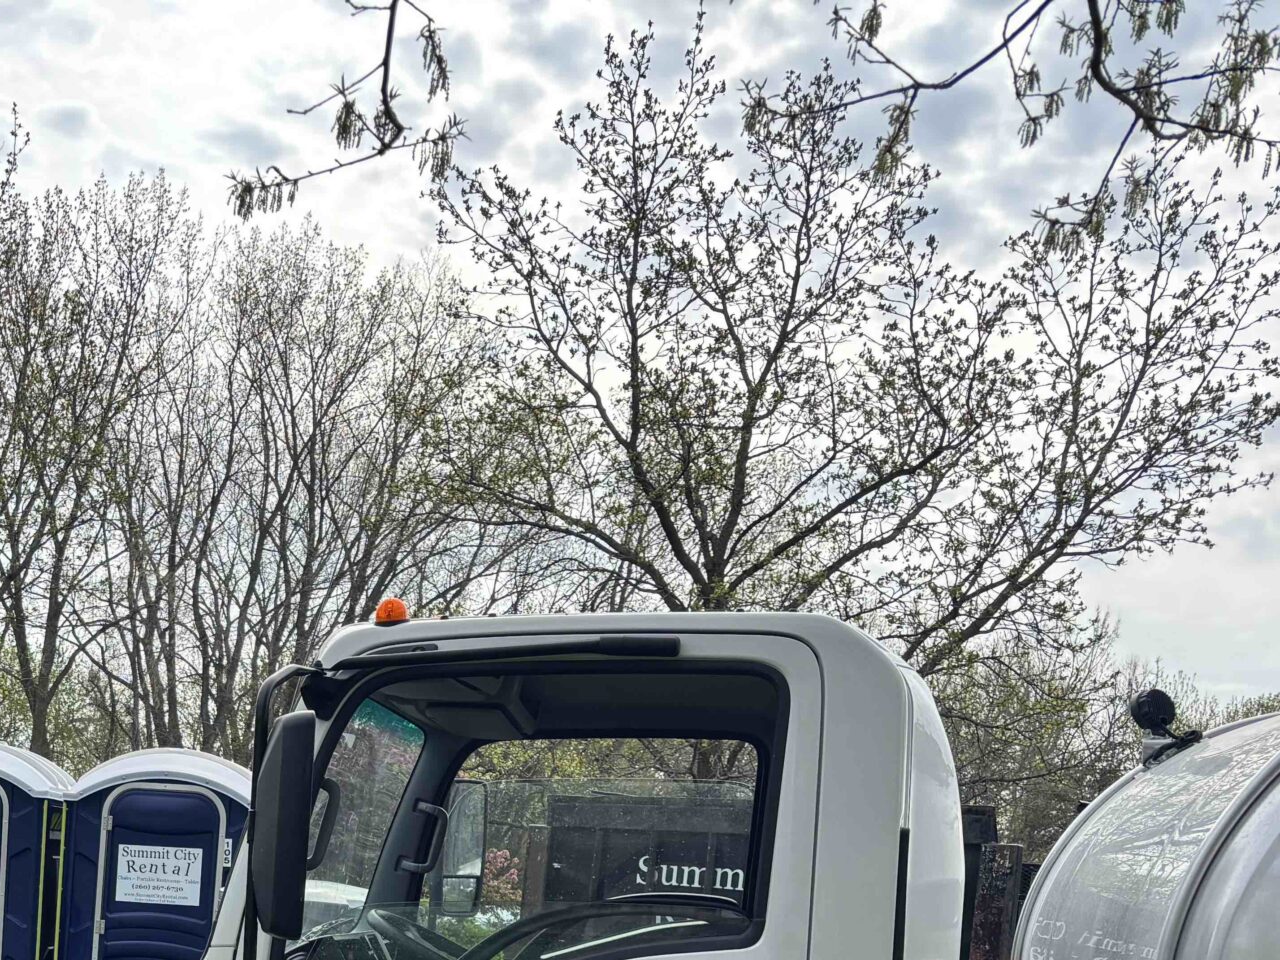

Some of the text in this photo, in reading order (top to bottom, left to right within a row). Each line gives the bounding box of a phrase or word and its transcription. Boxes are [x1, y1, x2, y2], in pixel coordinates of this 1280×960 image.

[122, 846, 199, 864] Summit City
[126, 860, 191, 876] Rental
